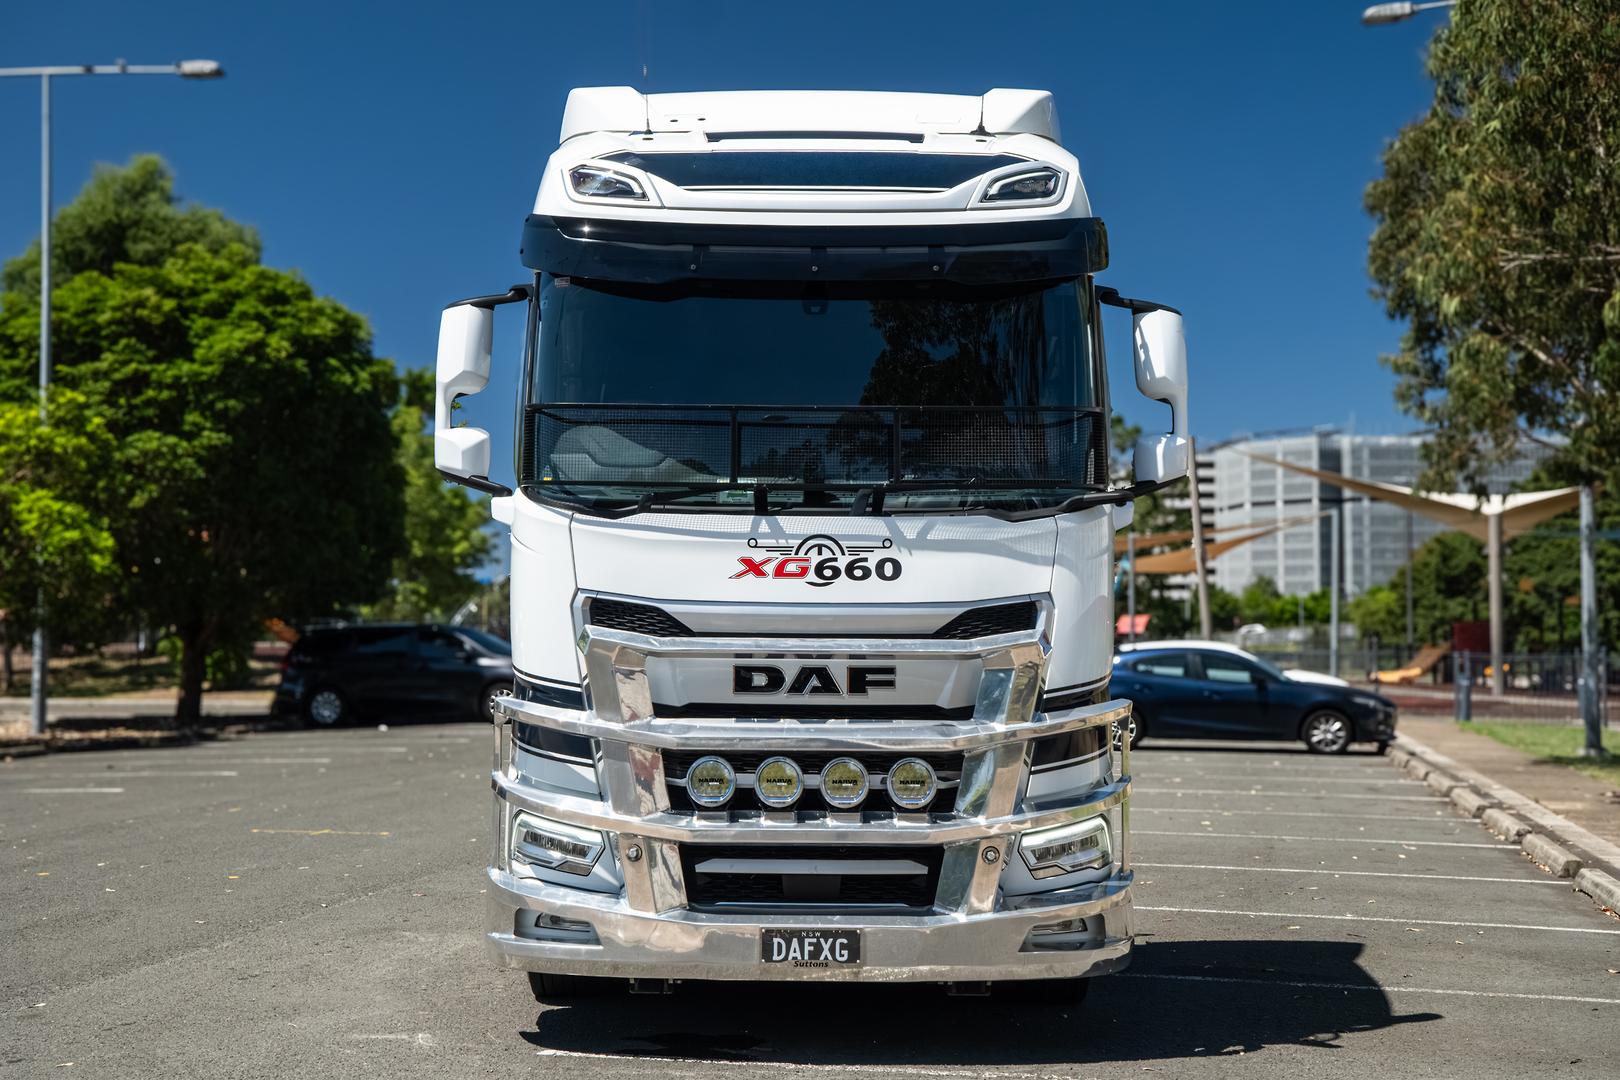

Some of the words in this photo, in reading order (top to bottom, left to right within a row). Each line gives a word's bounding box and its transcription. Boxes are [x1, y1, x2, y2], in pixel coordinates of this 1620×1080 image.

[728, 556, 902, 581] XG660
[733, 664, 896, 695] DAF
[772, 938, 849, 961] DAFXG
[793, 960, 829, 968] Suttons
